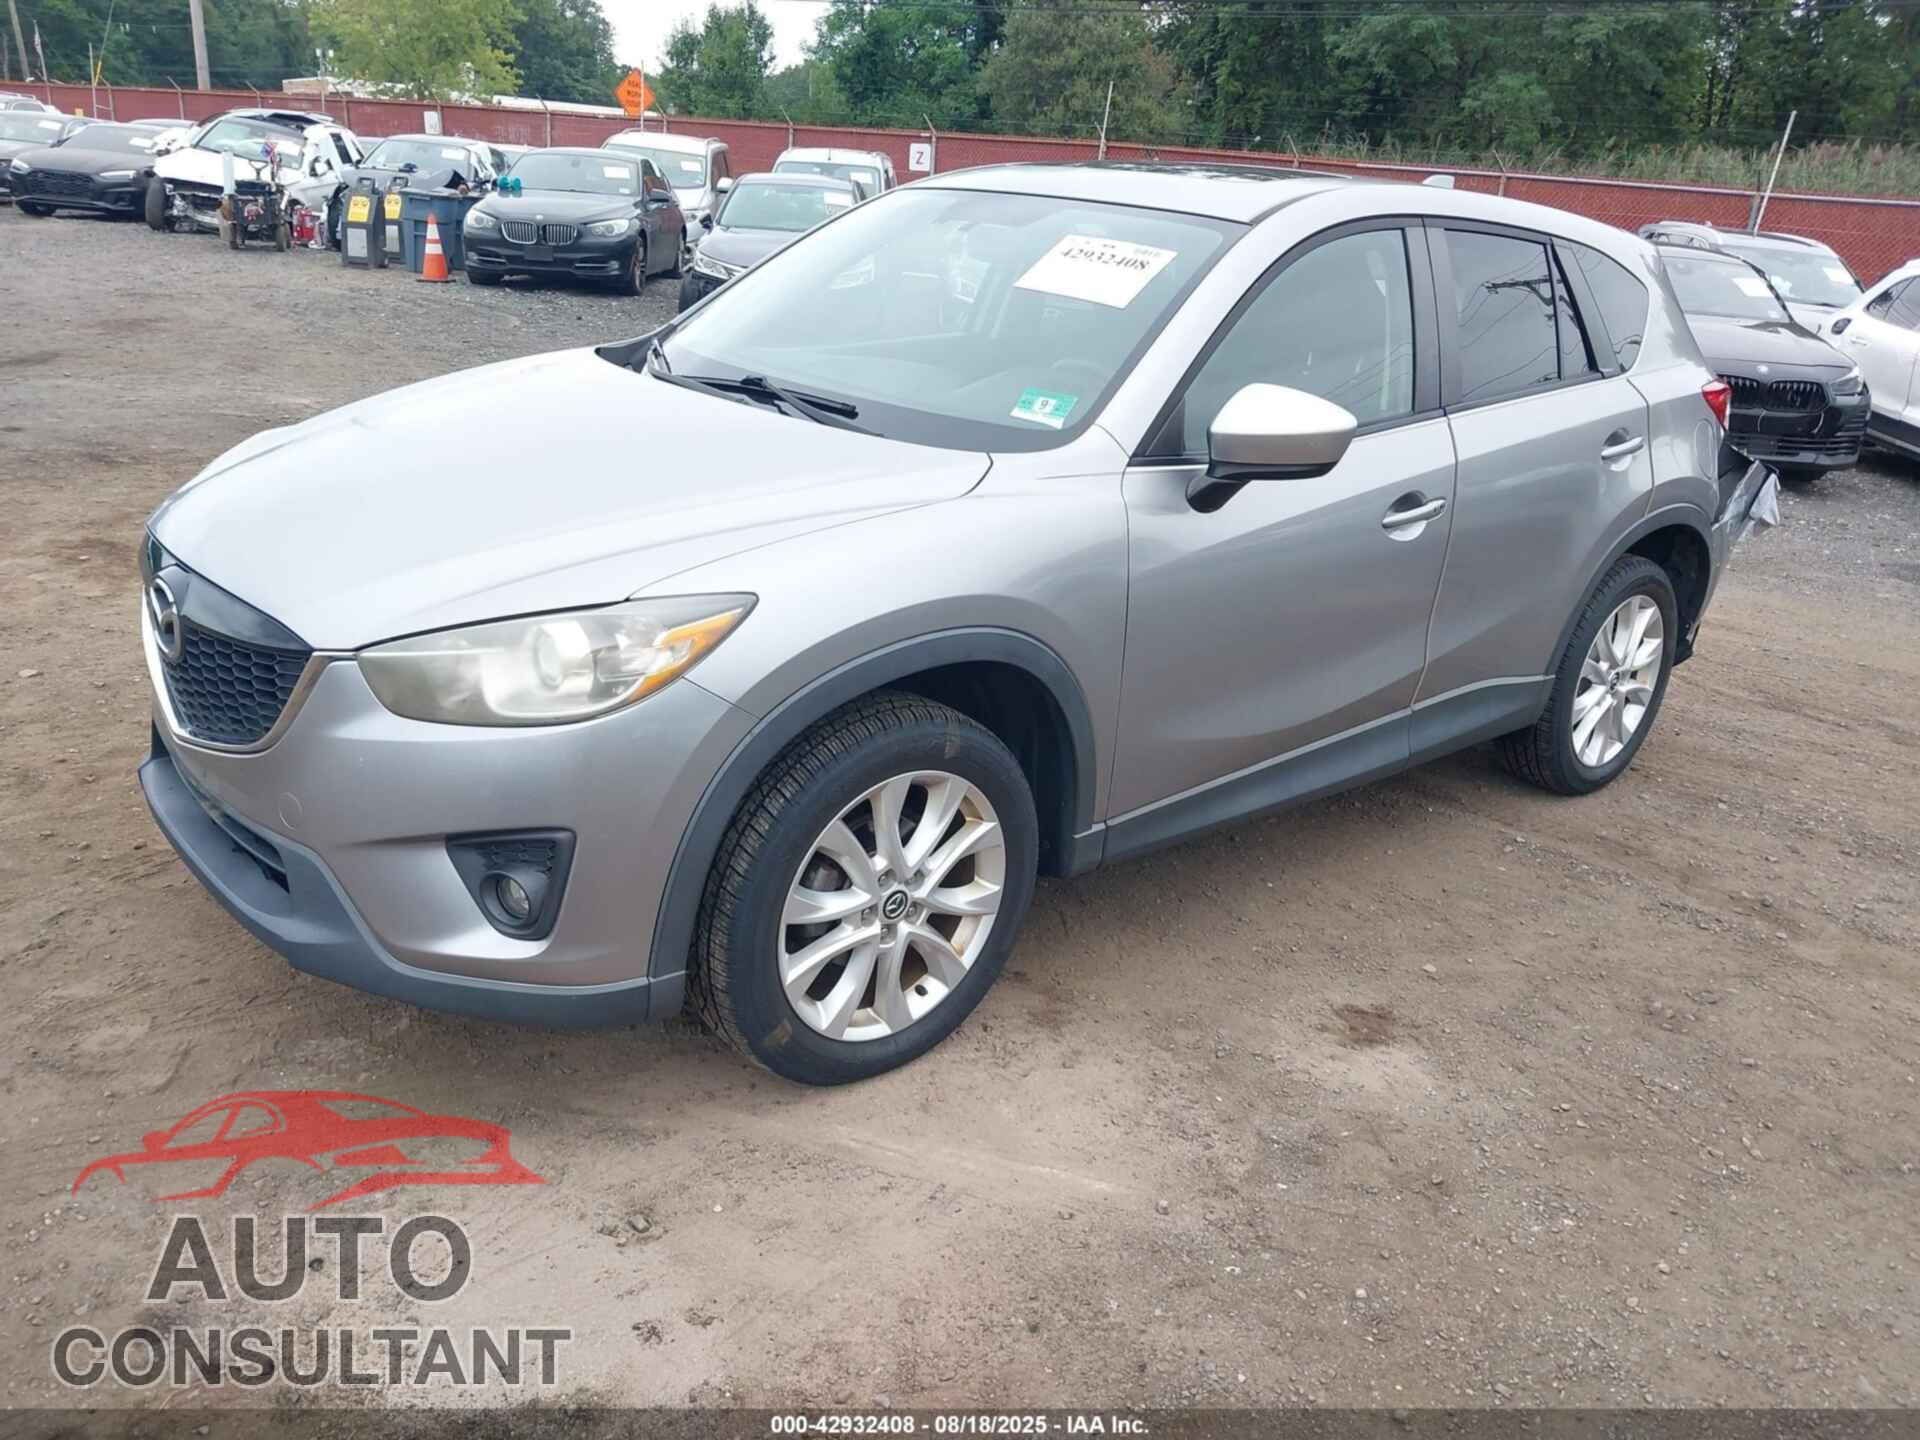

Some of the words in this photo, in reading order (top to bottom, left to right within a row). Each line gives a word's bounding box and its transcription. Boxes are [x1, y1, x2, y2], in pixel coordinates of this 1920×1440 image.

[915, 151, 925, 165] Z
[1061, 247, 1151, 271] 42932408
[1038, 399, 1049, 410] 9
